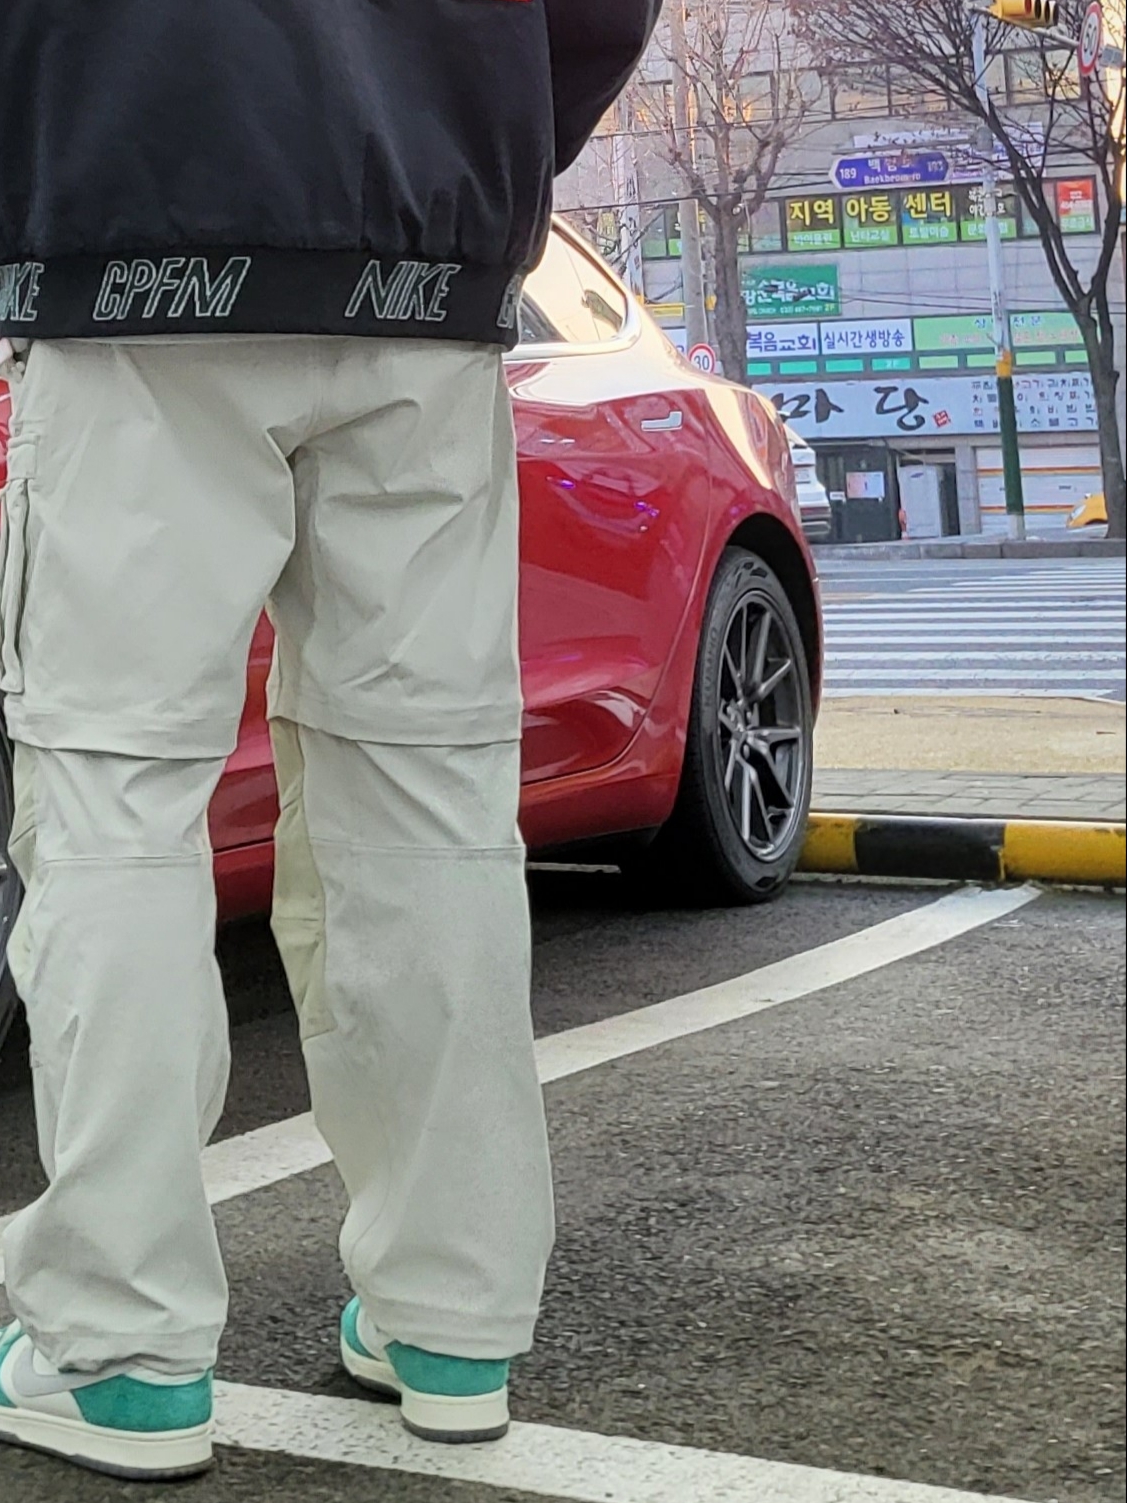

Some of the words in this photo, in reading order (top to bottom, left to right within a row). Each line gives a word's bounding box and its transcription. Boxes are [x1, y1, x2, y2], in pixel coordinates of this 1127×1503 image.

[839, 168, 857, 180] 189
[788, 198, 834, 225] 지역
[846, 195, 892, 223] 아동
[905, 191, 952, 219] 센터
[92, 256, 252, 321] CPFM
[344, 259, 462, 322] NIKE
[694, 355, 710, 371] 30
